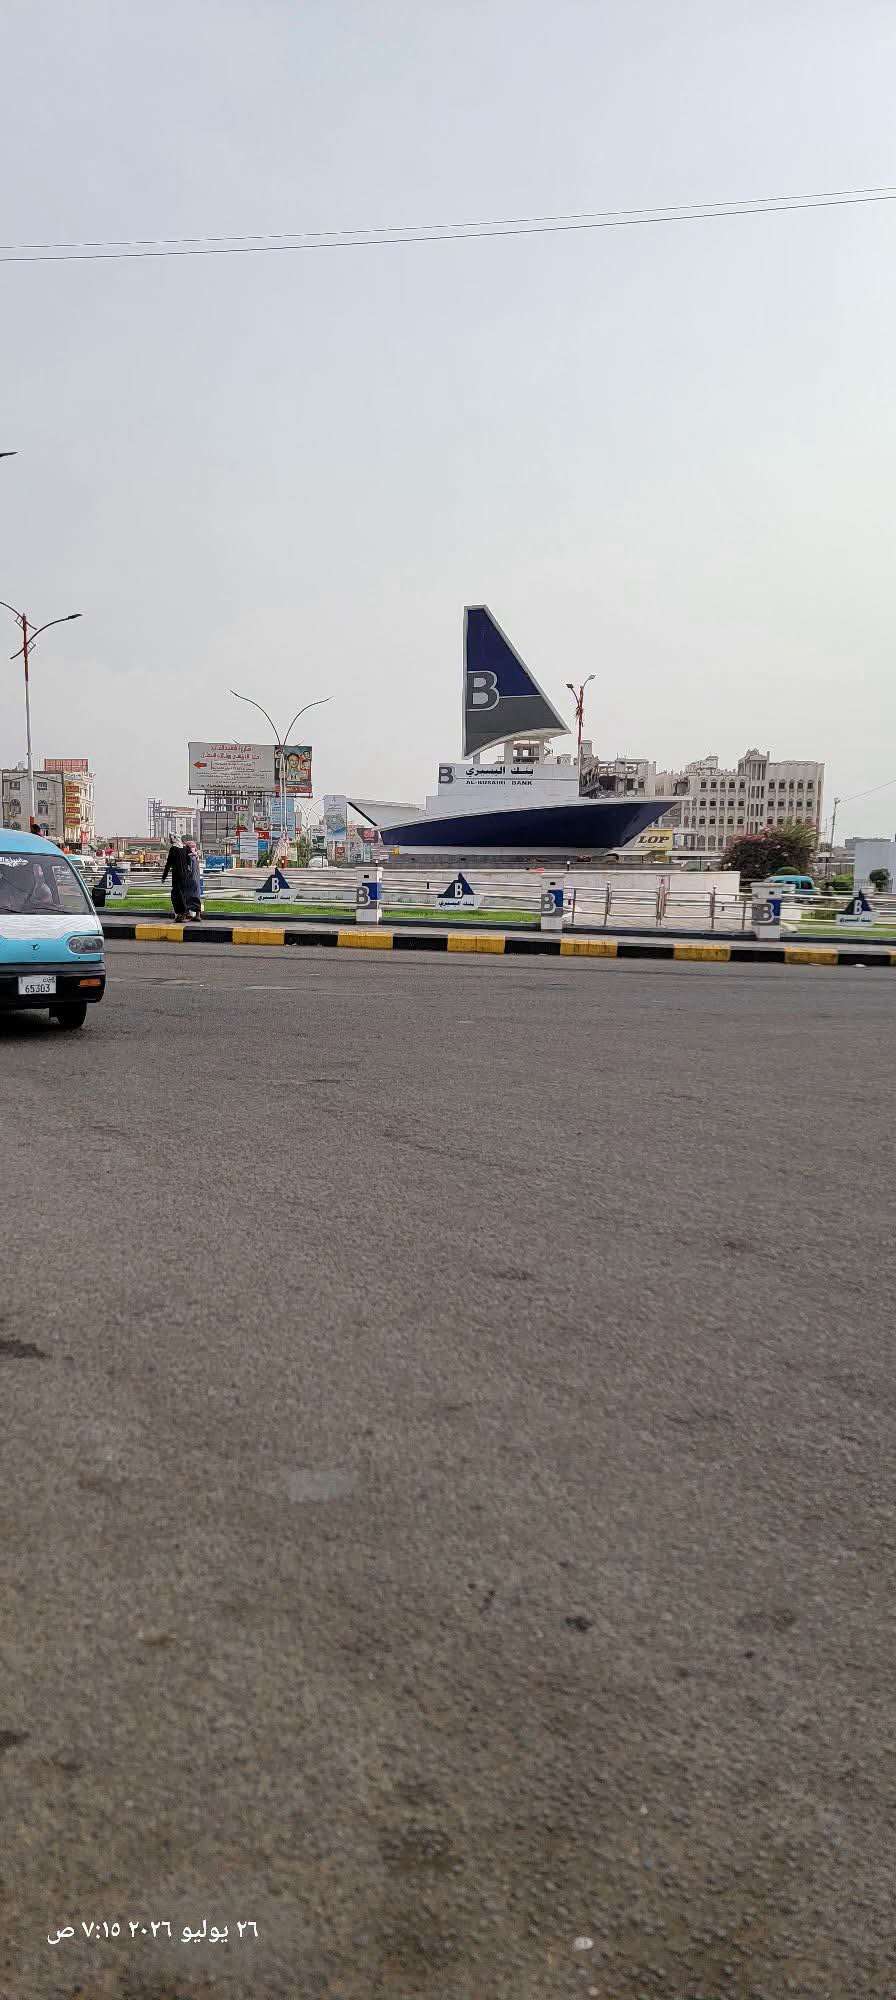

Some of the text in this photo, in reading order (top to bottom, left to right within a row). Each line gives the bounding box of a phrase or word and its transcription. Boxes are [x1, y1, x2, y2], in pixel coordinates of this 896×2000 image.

[467, 671, 500, 711] B
[438, 766, 456, 784] B
[465, 766, 533, 778] بنك البسيري
[107, 874, 113, 889] B
[272, 878, 280, 893] B
[455, 882, 463, 898] B
[356, 886, 370, 906] B
[541, 893, 556, 913] B
[757, 903, 774, 922] B
[854, 899, 863, 915] B
